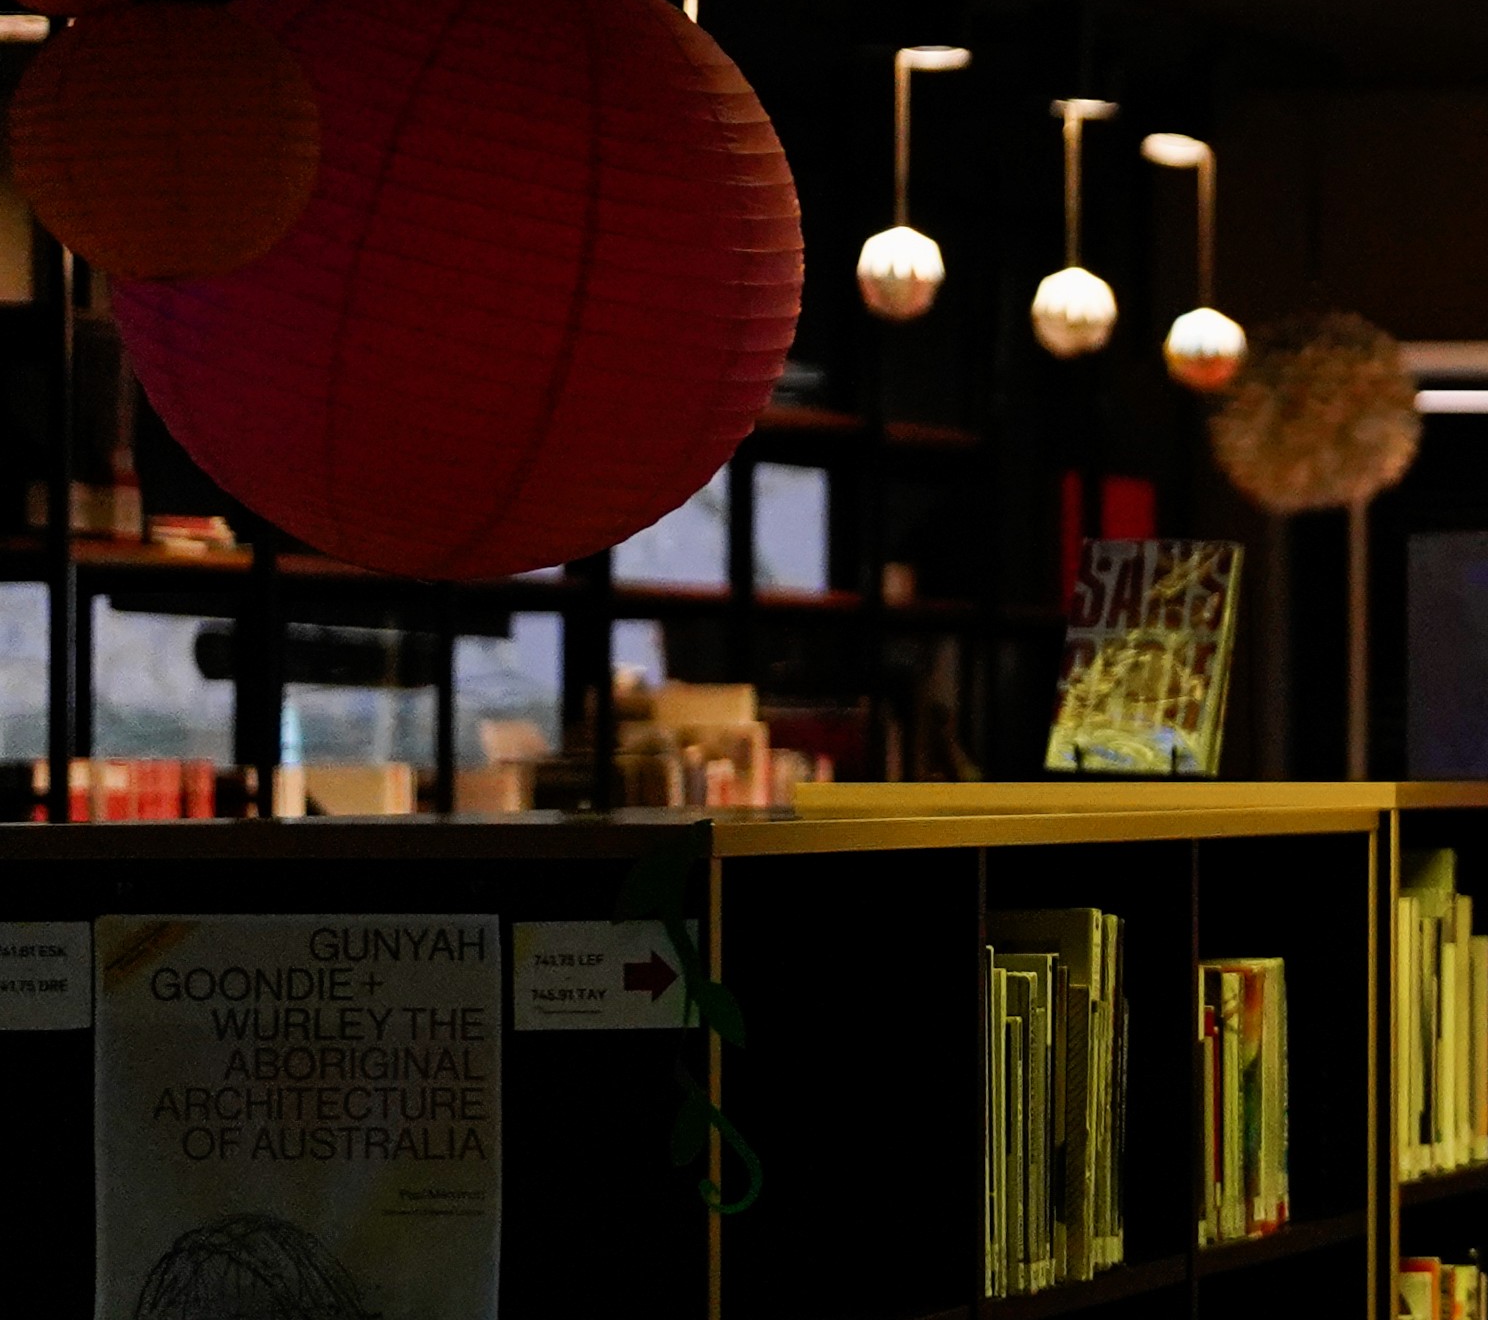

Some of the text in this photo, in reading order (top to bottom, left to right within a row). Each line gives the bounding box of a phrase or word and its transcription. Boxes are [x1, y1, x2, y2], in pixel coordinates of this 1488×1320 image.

[309, 927, 485, 963] GUNYAH
[151, 967, 385, 1002] GOONDIE +
[577, 988, 608, 1001] TAY
[211, 1007, 485, 1042] WURLEY THE
[224, 1047, 485, 1082] ABORIGINAL
[153, 1086, 486, 1122] ARCHITECTURE
[181, 1126, 486, 1162] OF AUSTRALIA
